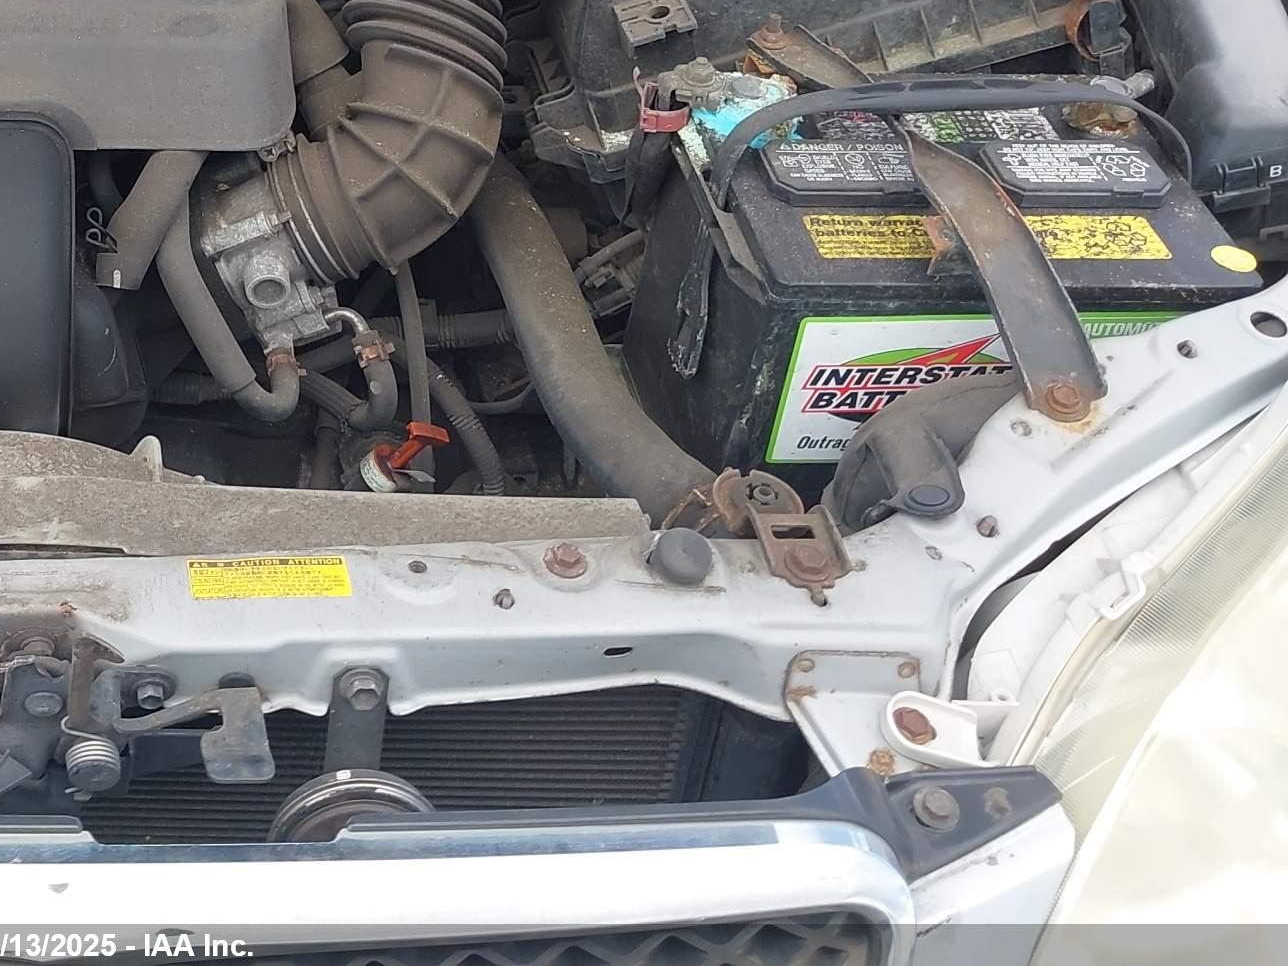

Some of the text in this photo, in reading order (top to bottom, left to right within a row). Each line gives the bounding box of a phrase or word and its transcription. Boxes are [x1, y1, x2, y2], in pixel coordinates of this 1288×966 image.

[792, 143, 844, 151] DANGER
[856, 143, 904, 151] POISON
[1270, 165, 1282, 177] B
[809, 217, 862, 226] Return
[815, 227, 886, 237] batteries
[892, 228, 906, 237] to
[232, 559, 280, 567] CAUTION
[288, 557, 340, 566] ATTENTION
